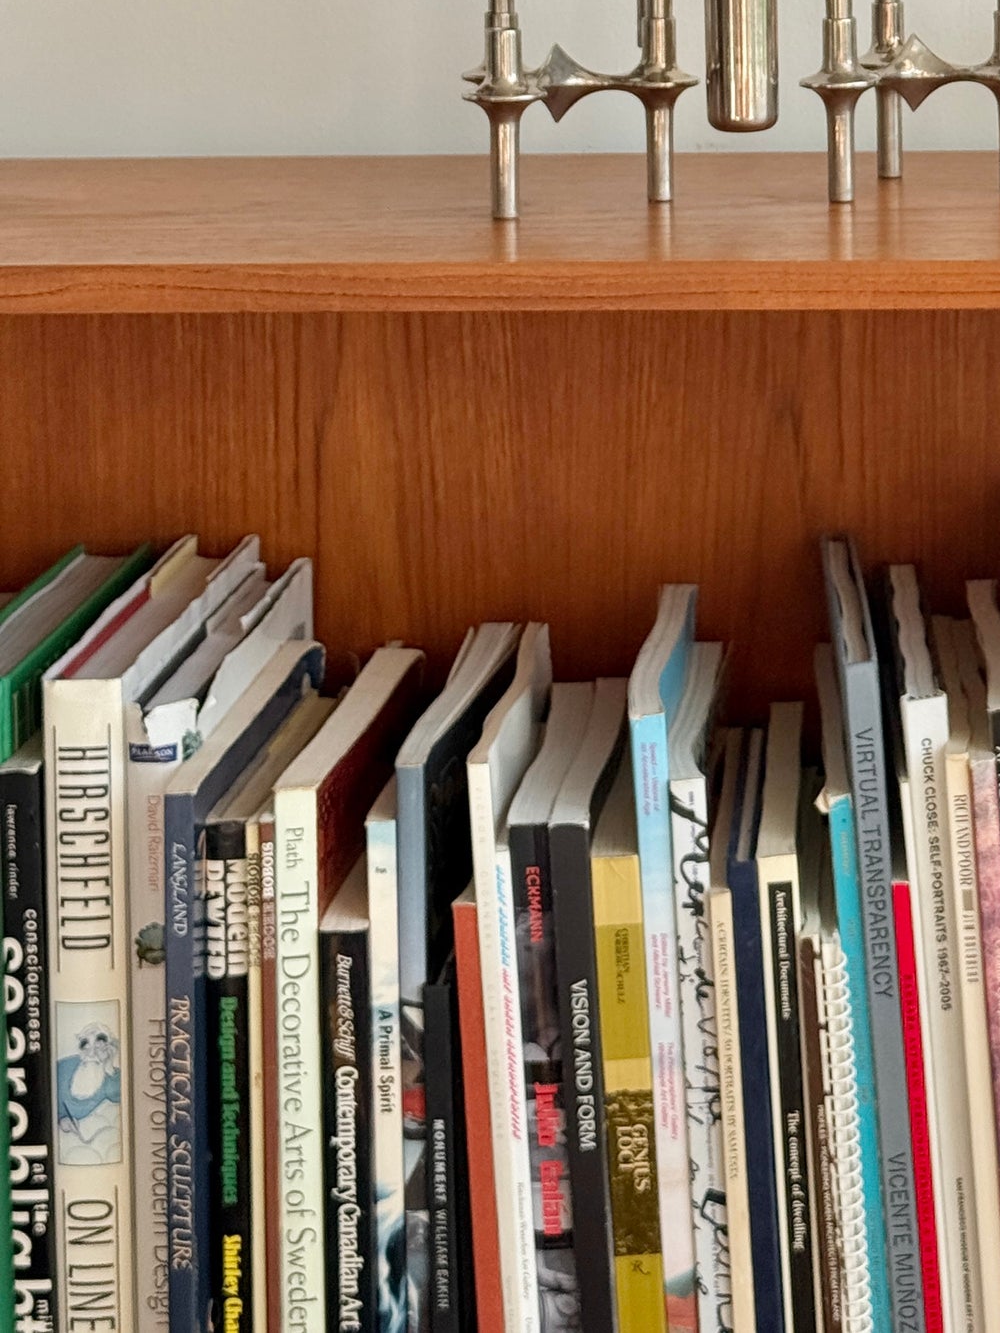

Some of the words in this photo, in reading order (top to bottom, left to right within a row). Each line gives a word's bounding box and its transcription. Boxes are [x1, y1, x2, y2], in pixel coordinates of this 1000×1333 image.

[853, 726, 878, 821] VIRTUAL
[920, 737, 934, 784] CHUCK
[146, 795, 163, 831] David
[925, 787, 939, 834] CLOSE:
[953, 794, 969, 825] RICH
[955, 826, 971, 850] AND
[58, 745, 112, 951] HIRSCHFELD
[284, 826, 305, 870] Plath
[957, 850, 973, 886] POOR
[171, 841, 189, 937] LANGLAND
[280, 881, 309, 942] The
[525, 865, 543, 943] ECKMANN
[862, 824, 895, 999] TRANSPARENCY
[928, 836, 946, 943] SELF-PORTRAITS
[775, 889, 791, 959] Architectural
[24, 908, 42, 1052] consciousness
[778, 960, 793, 1020] Documents
[218, 996, 239, 1061] Design
[280, 952, 312, 1113] Decorative
[378, 1009, 392, 1021] A
[570, 979, 593, 1046] VISION
[142, 1018, 169, 1107] History
[169, 995, 192, 1124] PRACTICAL
[378, 1025, 394, 1071] Primal
[573, 1048, 594, 1092] AND
[378, 1075, 395, 1114] Spirit
[723, 1053, 738, 1112] PORTRAITS
[329, 1065, 359, 1203] Contemporary
[533, 1081, 559, 1148] Julio
[575, 1094, 597, 1152] FORM
[727, 1114, 738, 1129] BY
[786, 1110, 802, 1135] The
[283, 1120, 314, 1181] Arts
[432, 1118, 447, 1202] MONUMENT
[615, 1126, 634, 1172] LOCI
[631, 1122, 652, 1193] GENIUS
[787, 1137, 804, 1181] concept
[170, 1135, 193, 1271] SCULPTURE
[285, 1190, 312, 1218] of
[790, 1183, 805, 1198] of
[886, 1152, 913, 1248] VICENTE
[67, 1199, 115, 1245] ON
[339, 1202, 364, 1295] Canadian
[434, 1208, 448, 1267] WILLIAM
[790, 1199, 808, 1251] dwelling
[147, 1255, 170, 1316] Design
[221, 1234, 242, 1296] Shirley
[893, 1253, 922, 1333] MUÑOZ
[69, 1264, 117, 1332] LINE
[340, 1294, 364, 1332] Art
